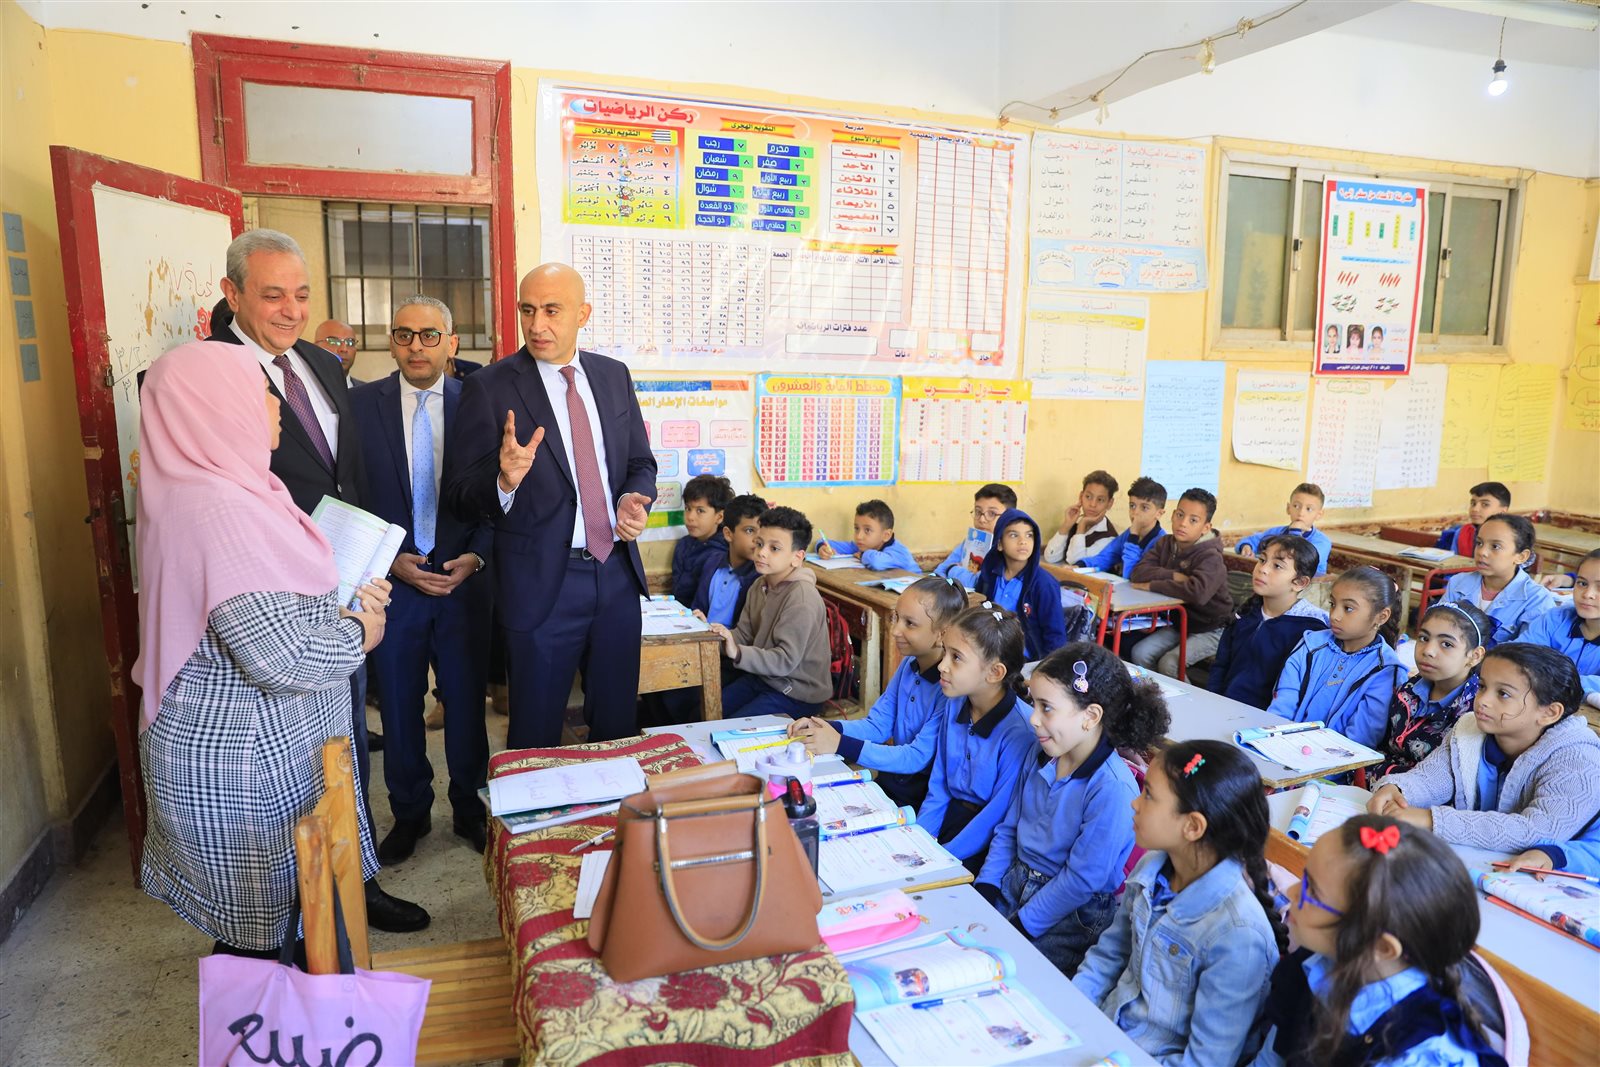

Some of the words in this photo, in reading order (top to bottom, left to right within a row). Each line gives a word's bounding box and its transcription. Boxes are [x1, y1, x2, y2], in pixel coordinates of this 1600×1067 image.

[583, 99, 655, 120] الرياضيات
[657, 105, 694, 123] ركن
[752, 124, 775, 132] التقويم
[845, 123, 864, 131] مدرسة
[615, 129, 640, 137] التقويم
[704, 139, 720, 149] رجب
[770, 145, 789, 154] محرم
[842, 149, 877, 158] السبت
[704, 155, 726, 164] شعبان
[762, 158, 777, 167] صفر
[843, 162, 873, 171] الأحد
[696, 170, 719, 179] رمضان
[779, 177, 792, 185] ربيع
[697, 185, 716, 194] شوال
[836, 186, 877, 196] الثلاثاء
[1356, 189, 1367, 199] صفر
[772, 191, 785, 200] ربيع
[1368, 189, 1375, 200] من
[1376, 191, 1393, 200] الأعداد
[1395, 191, 1413, 202] مقارنة
[700, 200, 722, 211] القعدة
[723, 203, 732, 211] ذو
[697, 215, 717, 224] الحجة
[833, 323, 851, 332] فترات
[773, 379, 822, 393] والعشرون
[856, 380, 885, 392] مخطط
[924, 383, 974, 397] الضرب
[974, 385, 1012, 398] جدول
[656, 397, 686, 408] الإطار
[687, 396, 728, 408] مواصفات
